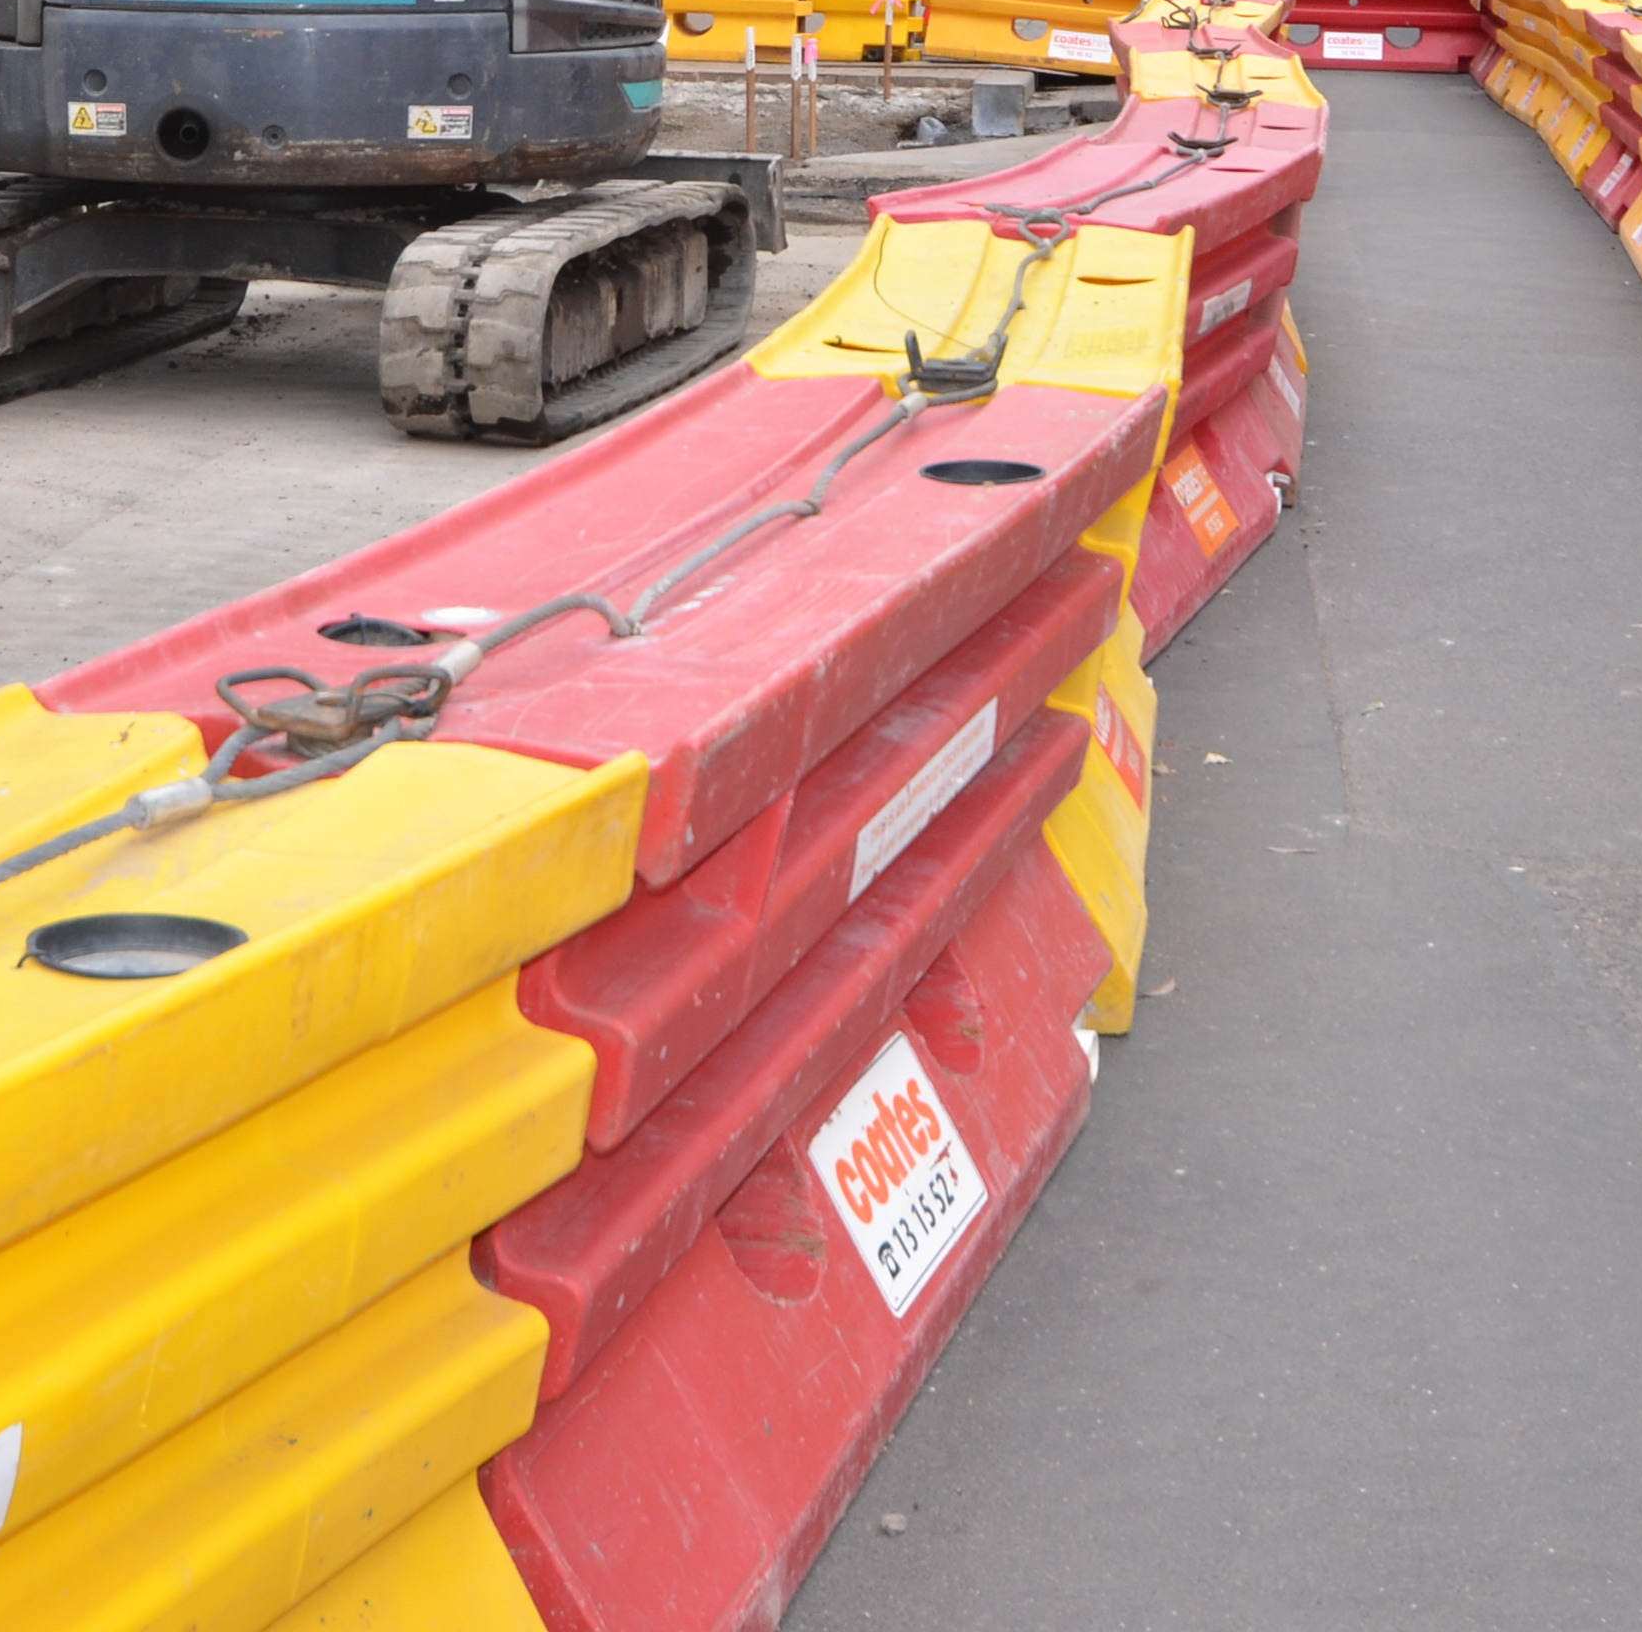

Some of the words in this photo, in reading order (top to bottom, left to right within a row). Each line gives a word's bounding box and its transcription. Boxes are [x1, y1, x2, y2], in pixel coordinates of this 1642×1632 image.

[835, 1078, 942, 1225] coates
[892, 1218, 919, 1260] 13
[911, 1194, 937, 1236] 15
[929, 1172, 955, 1215] 52
